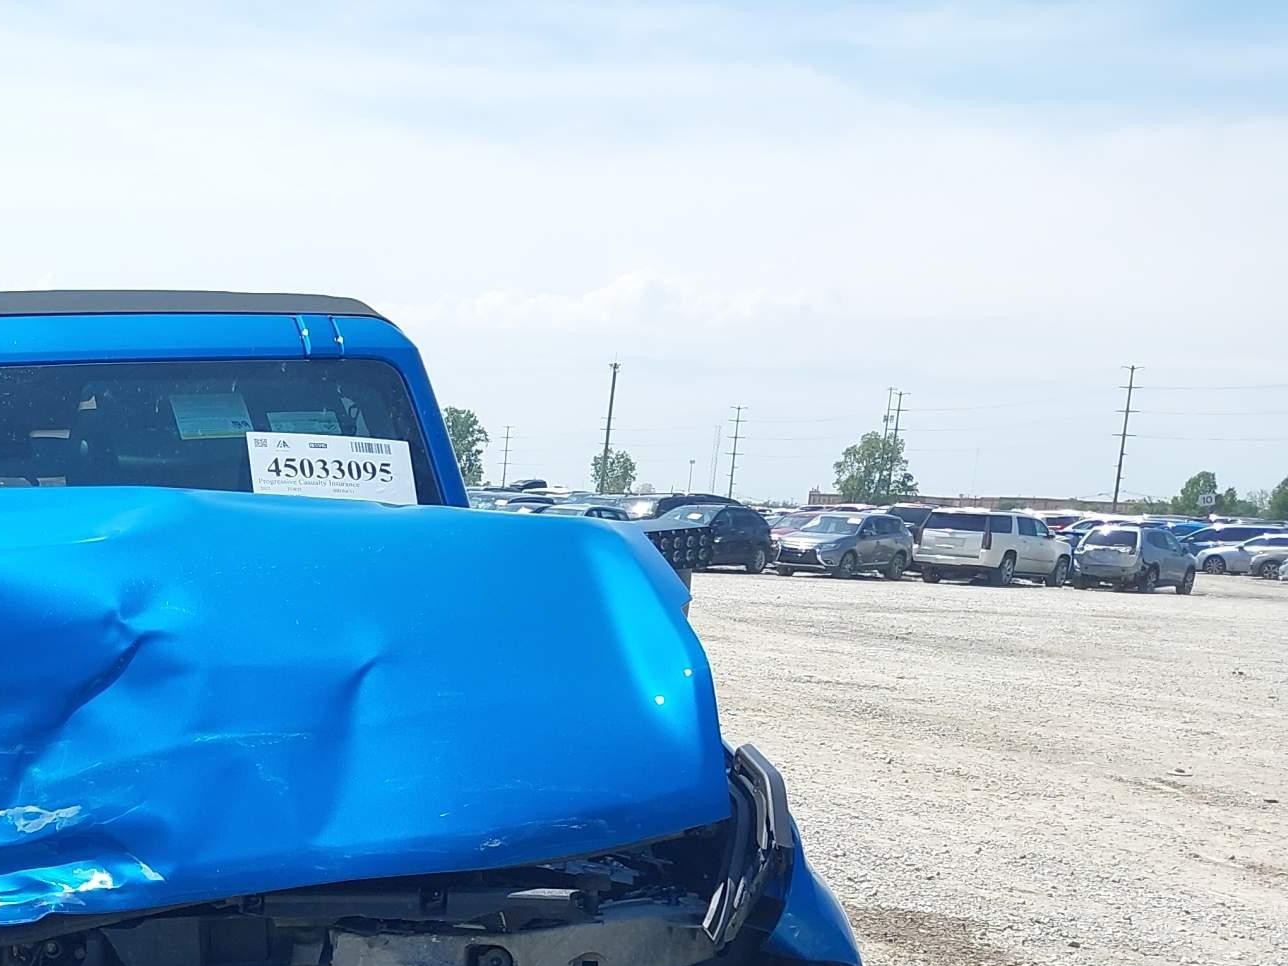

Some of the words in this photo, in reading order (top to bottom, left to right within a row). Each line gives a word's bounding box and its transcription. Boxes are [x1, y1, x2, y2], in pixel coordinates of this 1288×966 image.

[267, 457, 393, 483] 45033095
[258, 477, 297, 486] Progressive
[298, 479, 327, 487] Casualty
[328, 480, 361, 488] Insurance
[1202, 495, 1213, 504] 10
